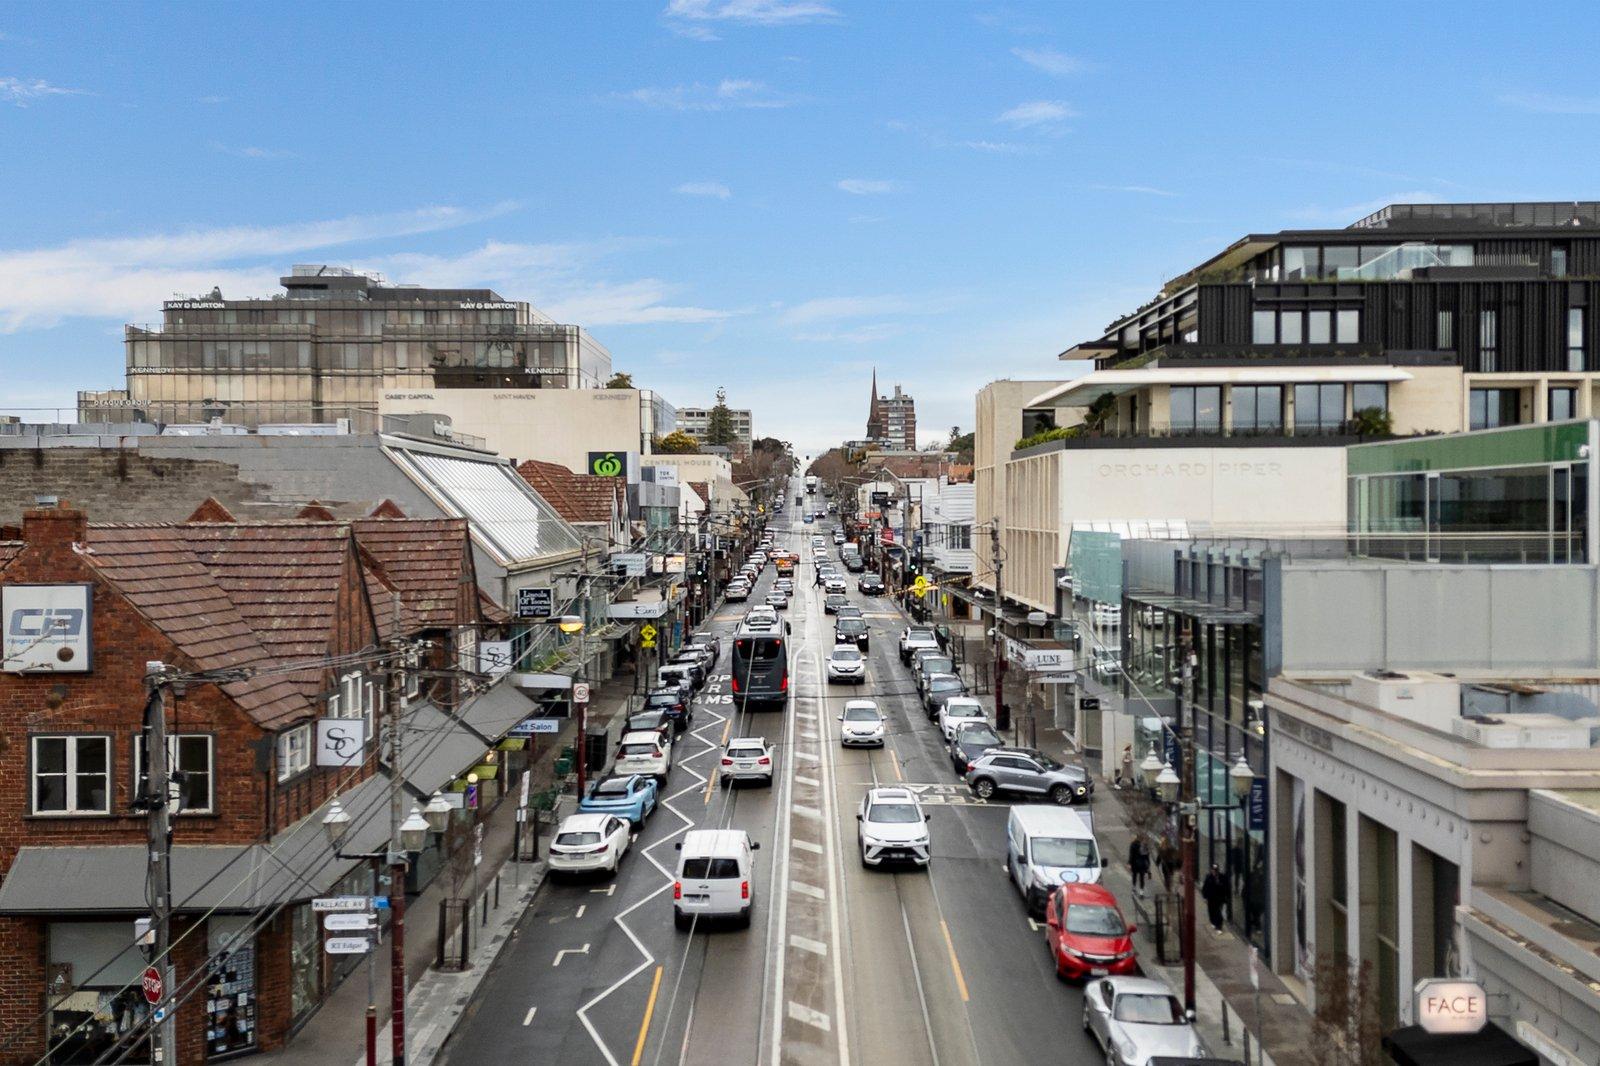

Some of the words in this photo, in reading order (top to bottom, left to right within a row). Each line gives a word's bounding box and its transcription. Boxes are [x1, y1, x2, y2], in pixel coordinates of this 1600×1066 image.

[1099, 463, 1207, 477] ORCHARD
[1218, 462, 1282, 476] PIPER
[706, 674, 731, 683] OP
[531, 723, 553, 731] Salon
[143, 977, 161, 993] STOP
[1428, 996, 1478, 1014] FACE
